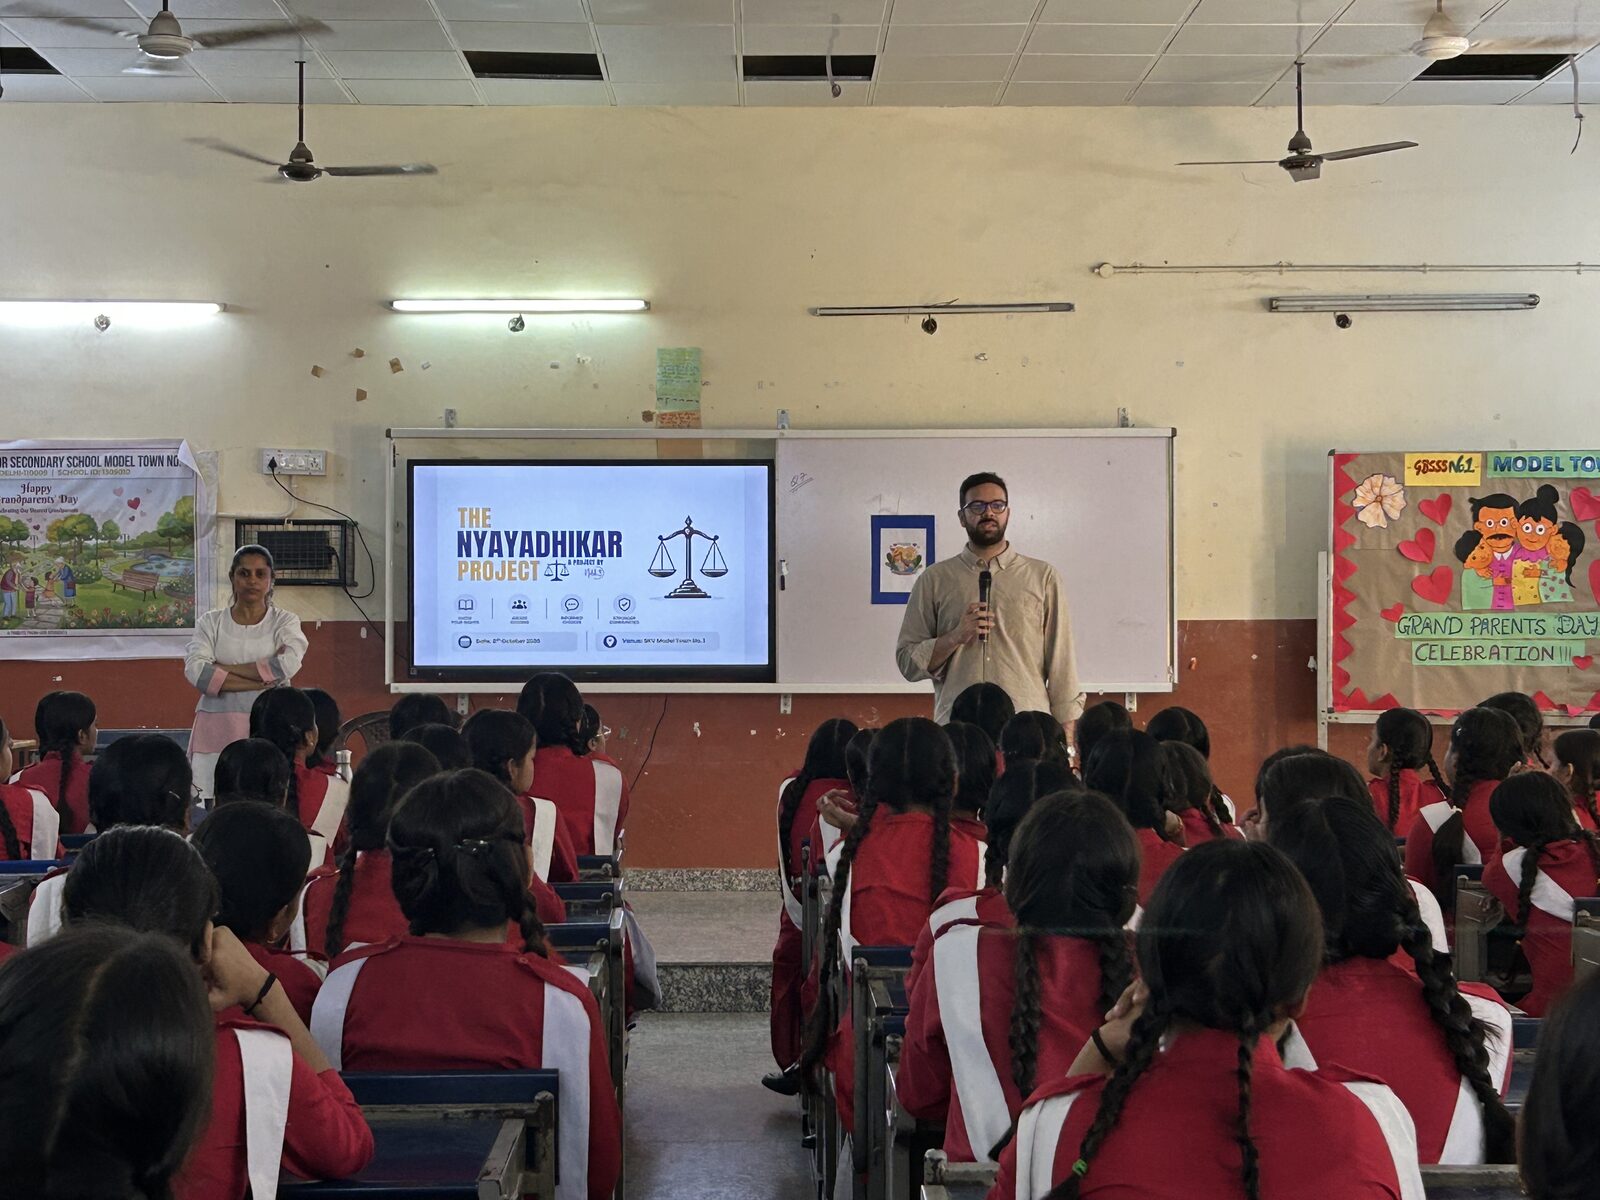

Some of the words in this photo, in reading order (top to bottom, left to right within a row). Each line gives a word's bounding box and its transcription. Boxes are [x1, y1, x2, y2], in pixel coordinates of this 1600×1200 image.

[10, 456, 65, 468] SECONDARY
[66, 456, 102, 468] SCHOOL
[104, 455, 135, 467] MODEL
[138, 455, 163, 467] TOWN
[1493, 456, 1565, 472] MODEL
[20, 482, 52, 495] Happy
[58, 494, 79, 505] Day
[457, 507, 492, 529] THE
[457, 530, 623, 558] NYAYADHIKAR
[457, 560, 540, 582] PROJECT
[1397, 614, 1463, 636] GRAND
[1470, 616, 1546, 636] PARENTS
[1556, 614, 1599, 636] DAY
[1415, 643, 1554, 662] CELEBRATION
